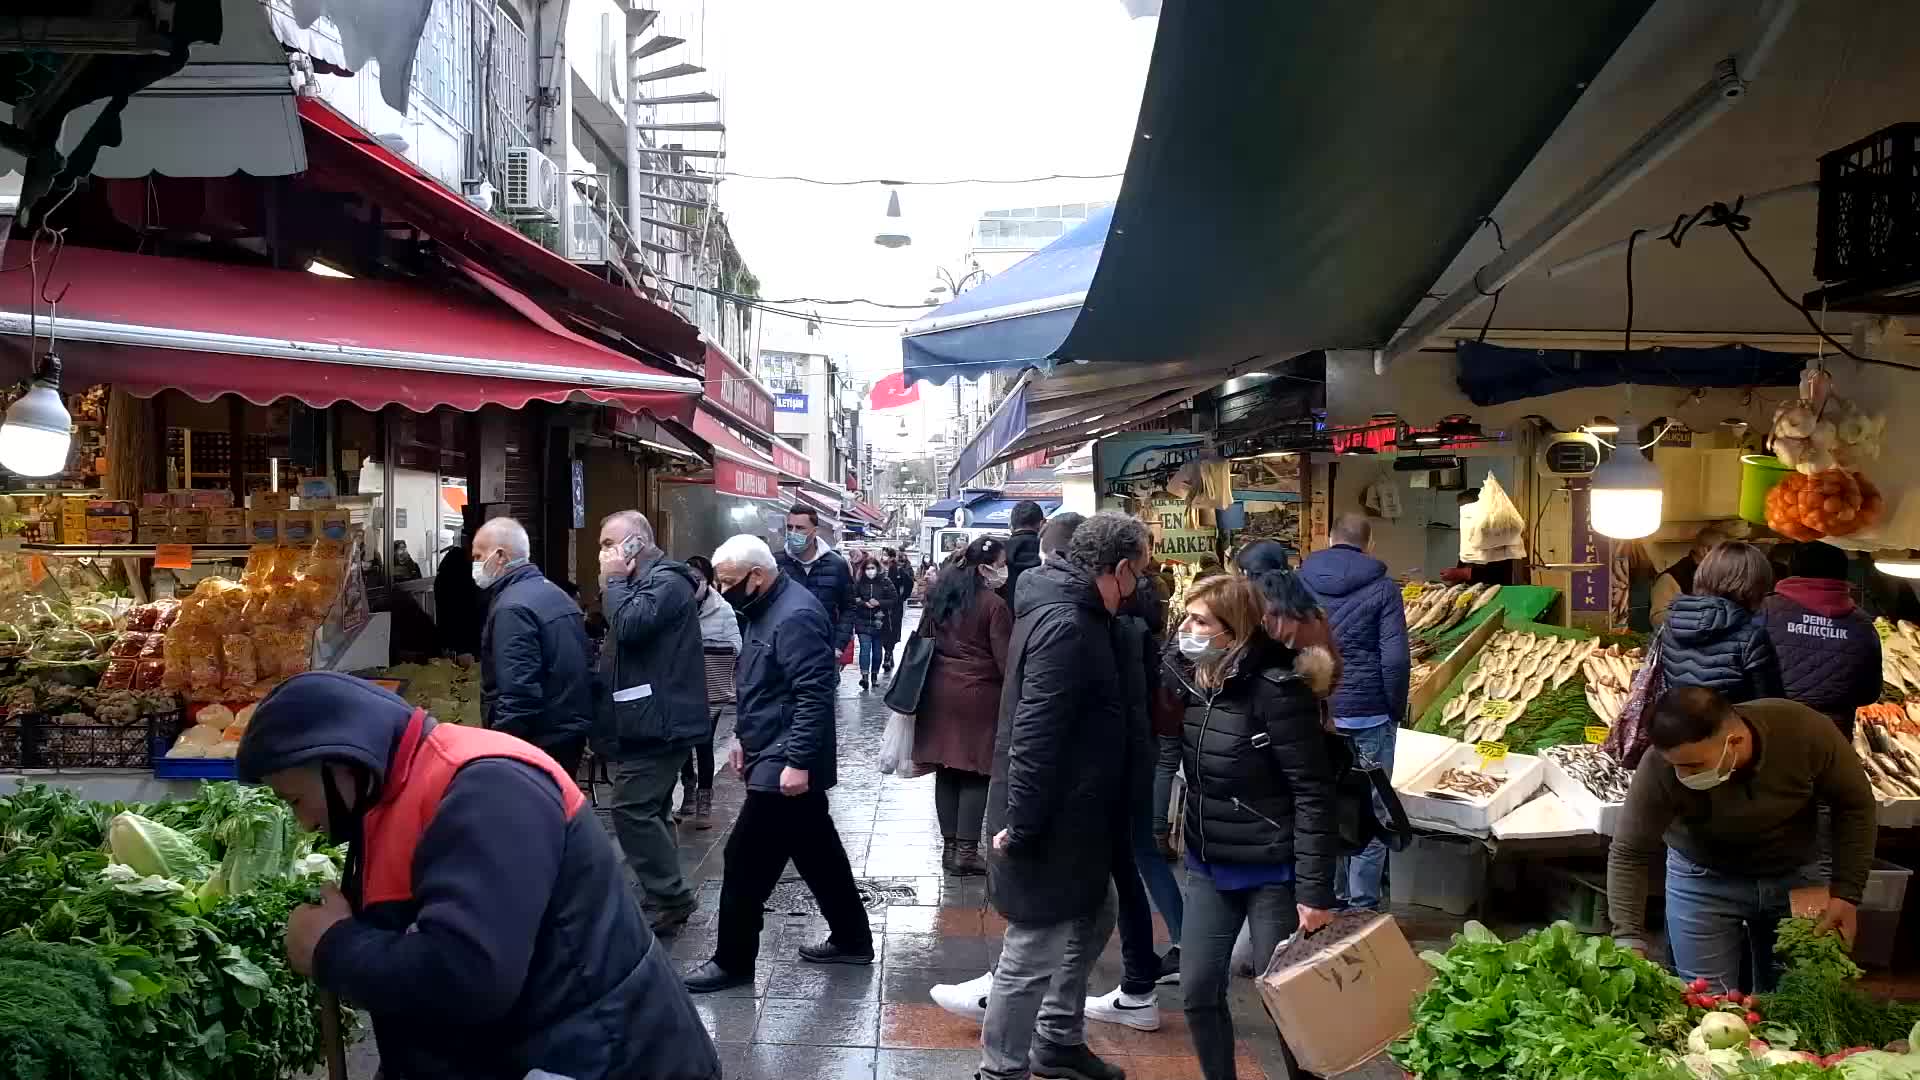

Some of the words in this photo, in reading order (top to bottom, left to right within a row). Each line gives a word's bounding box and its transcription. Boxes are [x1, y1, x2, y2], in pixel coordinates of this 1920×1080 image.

[866, 473, 873, 486] LC
[1154, 535, 1217, 554] MARKET
[1787, 622, 1849, 640] BALIKÇILIK
